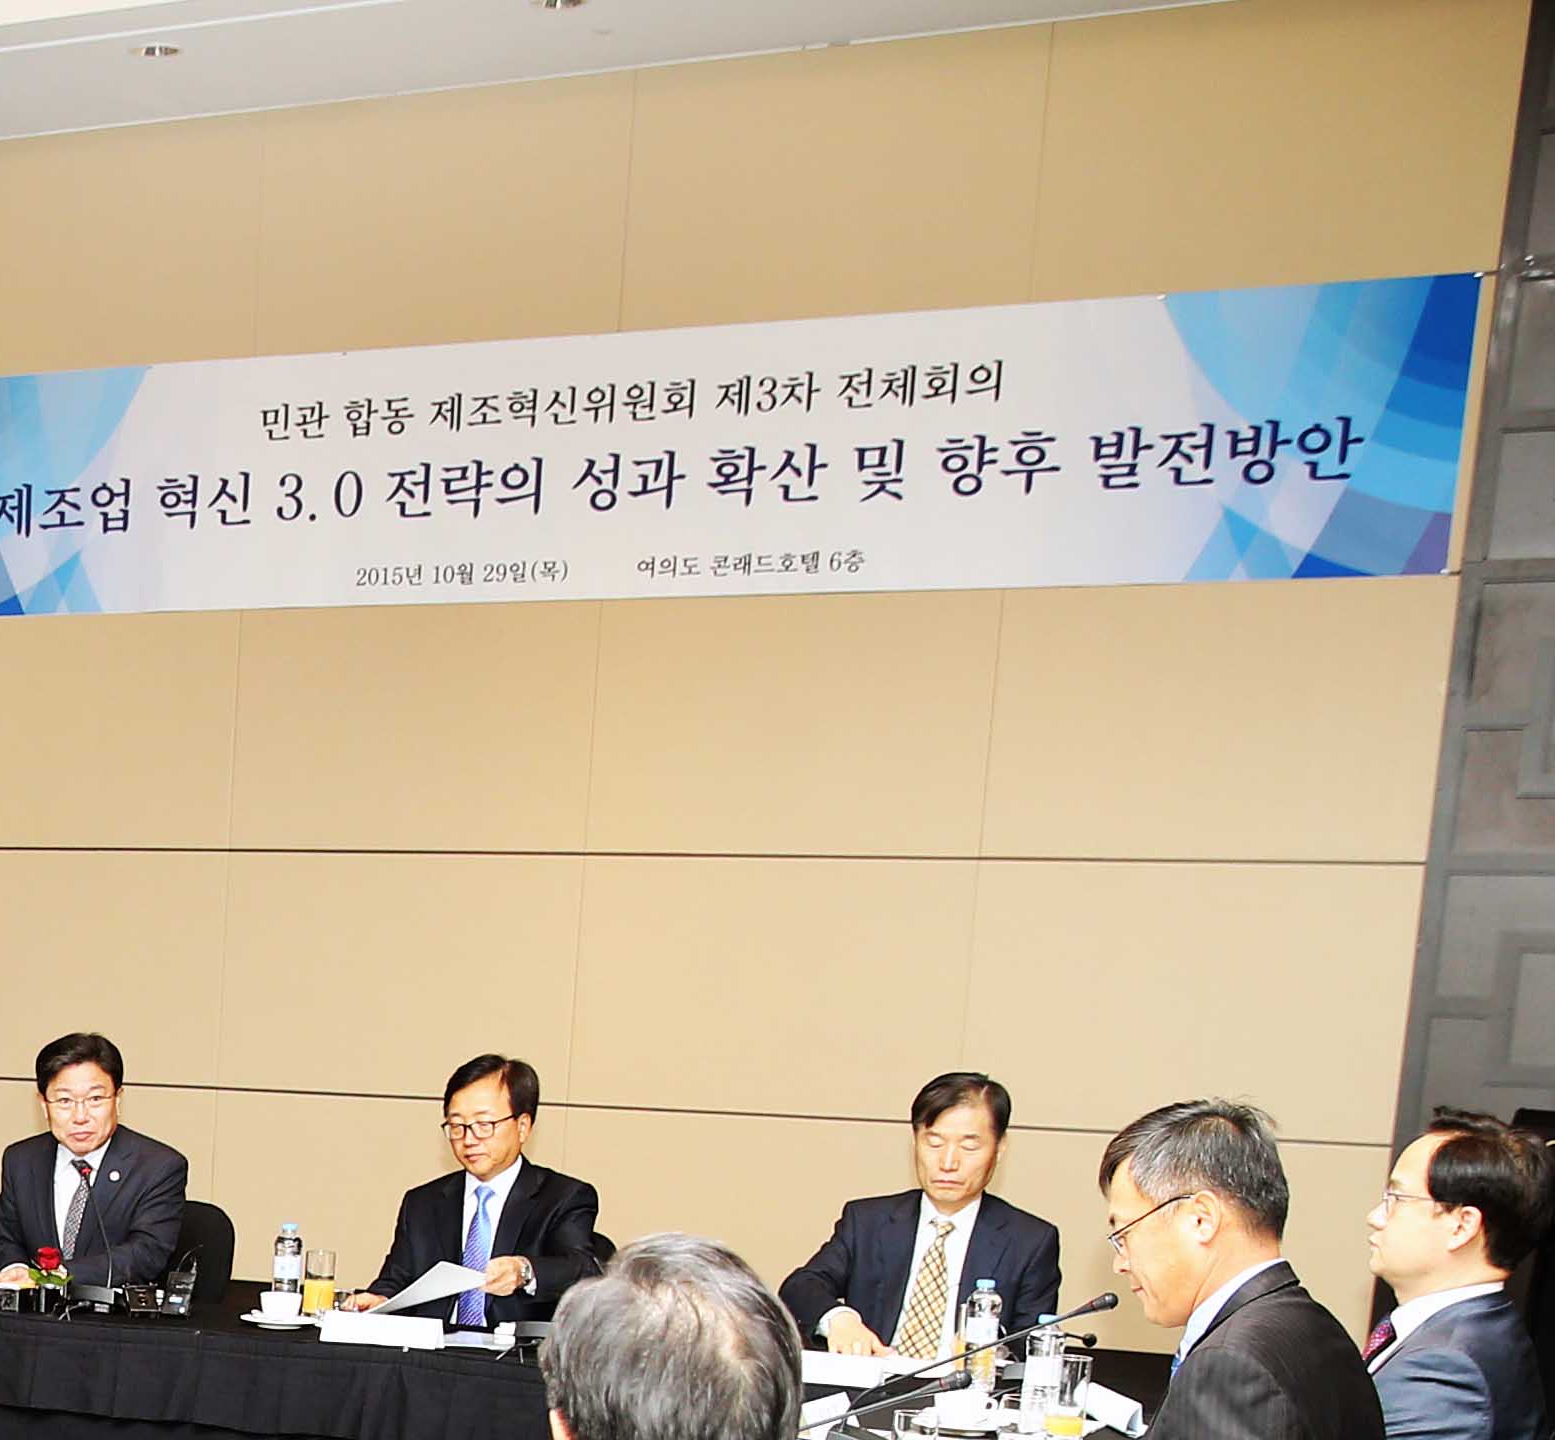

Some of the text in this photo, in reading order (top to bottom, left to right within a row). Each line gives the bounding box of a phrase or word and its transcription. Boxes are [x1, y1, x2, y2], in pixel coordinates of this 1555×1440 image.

[260, 359, 1004, 441] 민관 합동 제조혁신위원회 제3차 전체회의
[156, 471, 252, 530] 혁신
[276, 470, 363, 522] 3.0
[385, 455, 544, 520] 전략의
[571, 449, 687, 513] 성과
[706, 442, 830, 508] 확산
[853, 437, 905, 503] 및
[935, 430, 1062, 497] 향후
[1088, 415, 1366, 490] 발전방안
[356, 549, 865, 587] 2015년 10월 29일(목) 여의도 콘래드호텔 6층
